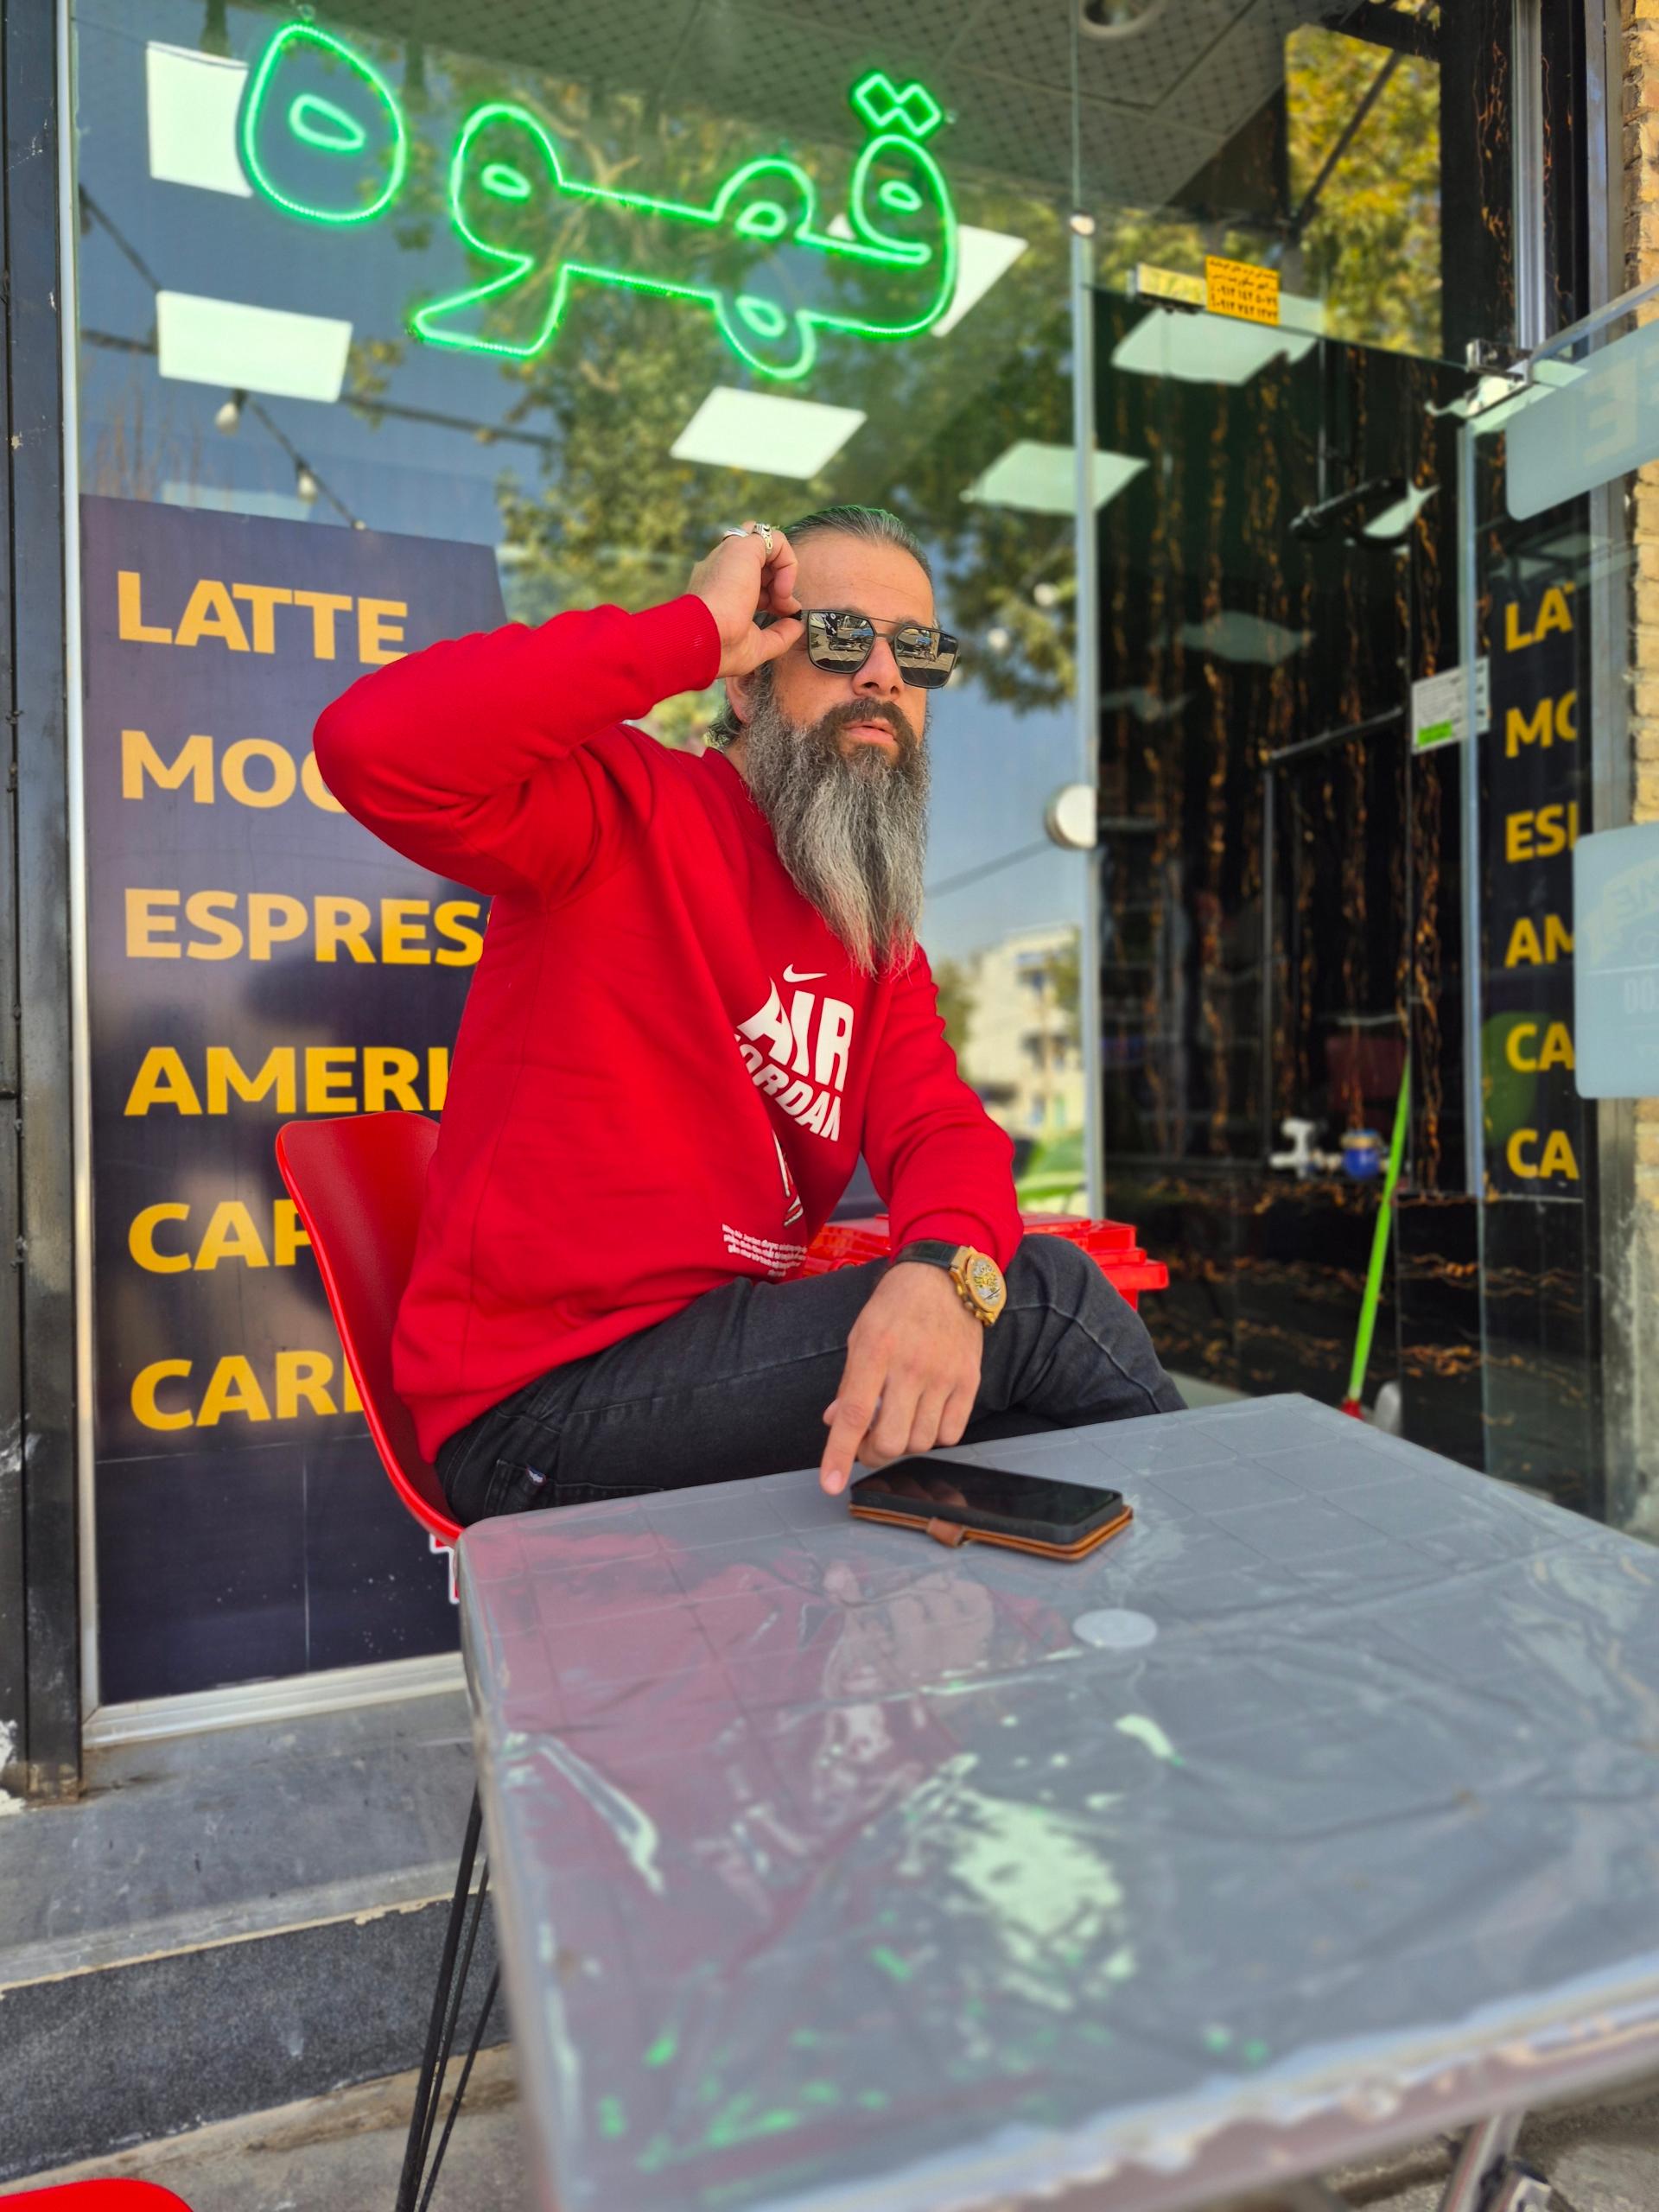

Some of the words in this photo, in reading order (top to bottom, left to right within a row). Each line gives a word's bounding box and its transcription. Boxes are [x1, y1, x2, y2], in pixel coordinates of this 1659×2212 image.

[243, 22, 959, 381] قهوه
[118, 570, 408, 665] LATTE
[1506, 582, 1574, 652] LA
[736, 976, 855, 1092] AIR
[734, 1033, 842, 1142] ORDAN
[130, 1350, 364, 1432] CAR
